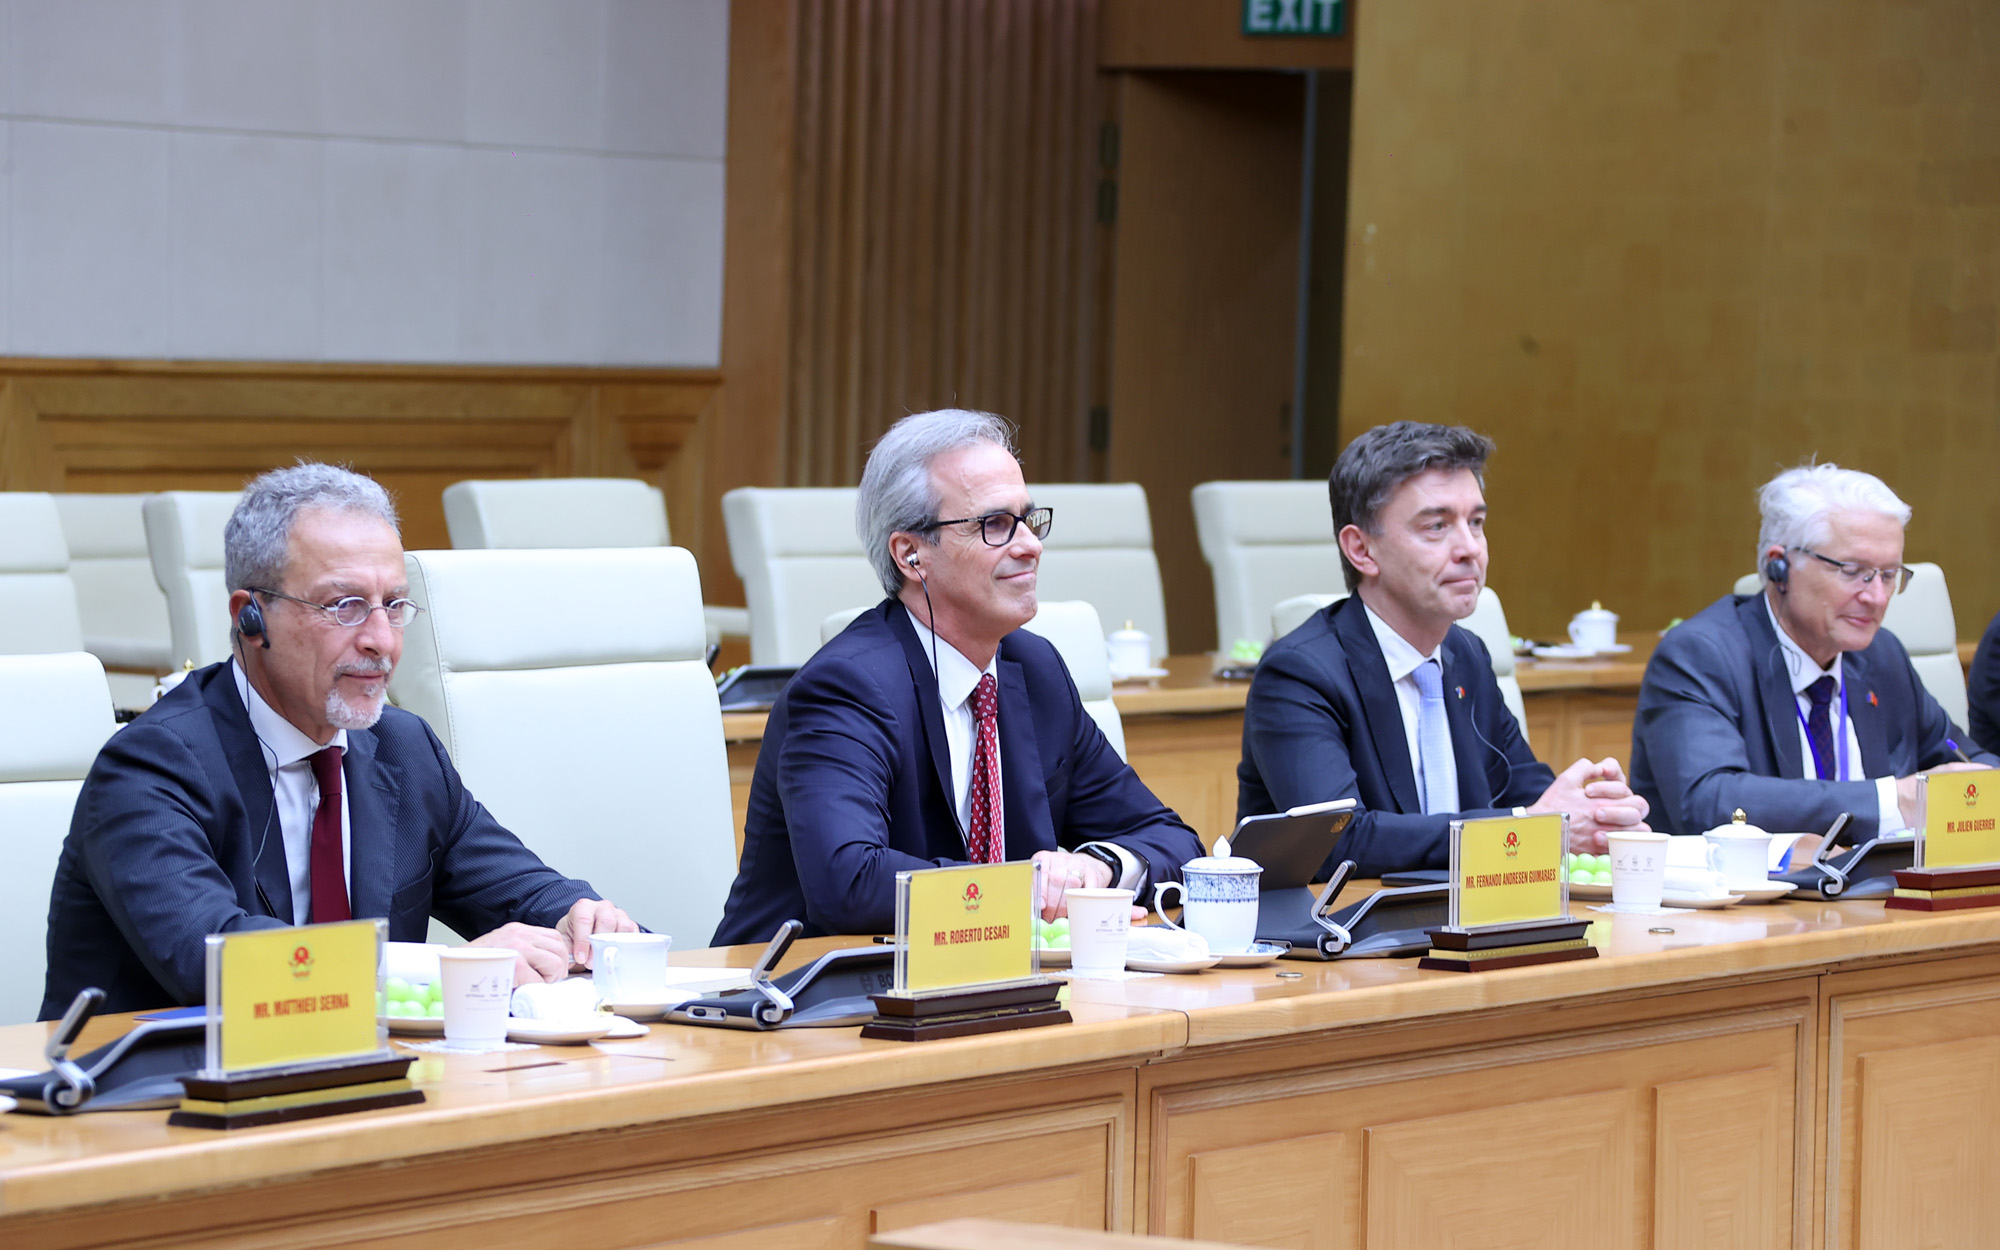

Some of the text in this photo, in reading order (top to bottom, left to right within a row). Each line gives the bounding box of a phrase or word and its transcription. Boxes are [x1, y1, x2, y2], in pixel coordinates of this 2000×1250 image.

[1247, 0, 1339, 31] EXIT
[1957, 820, 1973, 833] JULIEN
[1465, 875, 1476, 889] MR.
[1476, 873, 1502, 888] FERNANDO
[1502, 871, 1529, 886] ANDRESEN
[934, 925, 1010, 946] MR. ROBERTO CESARI
[253, 993, 349, 1019] MR. MATTHIEU SERNA
